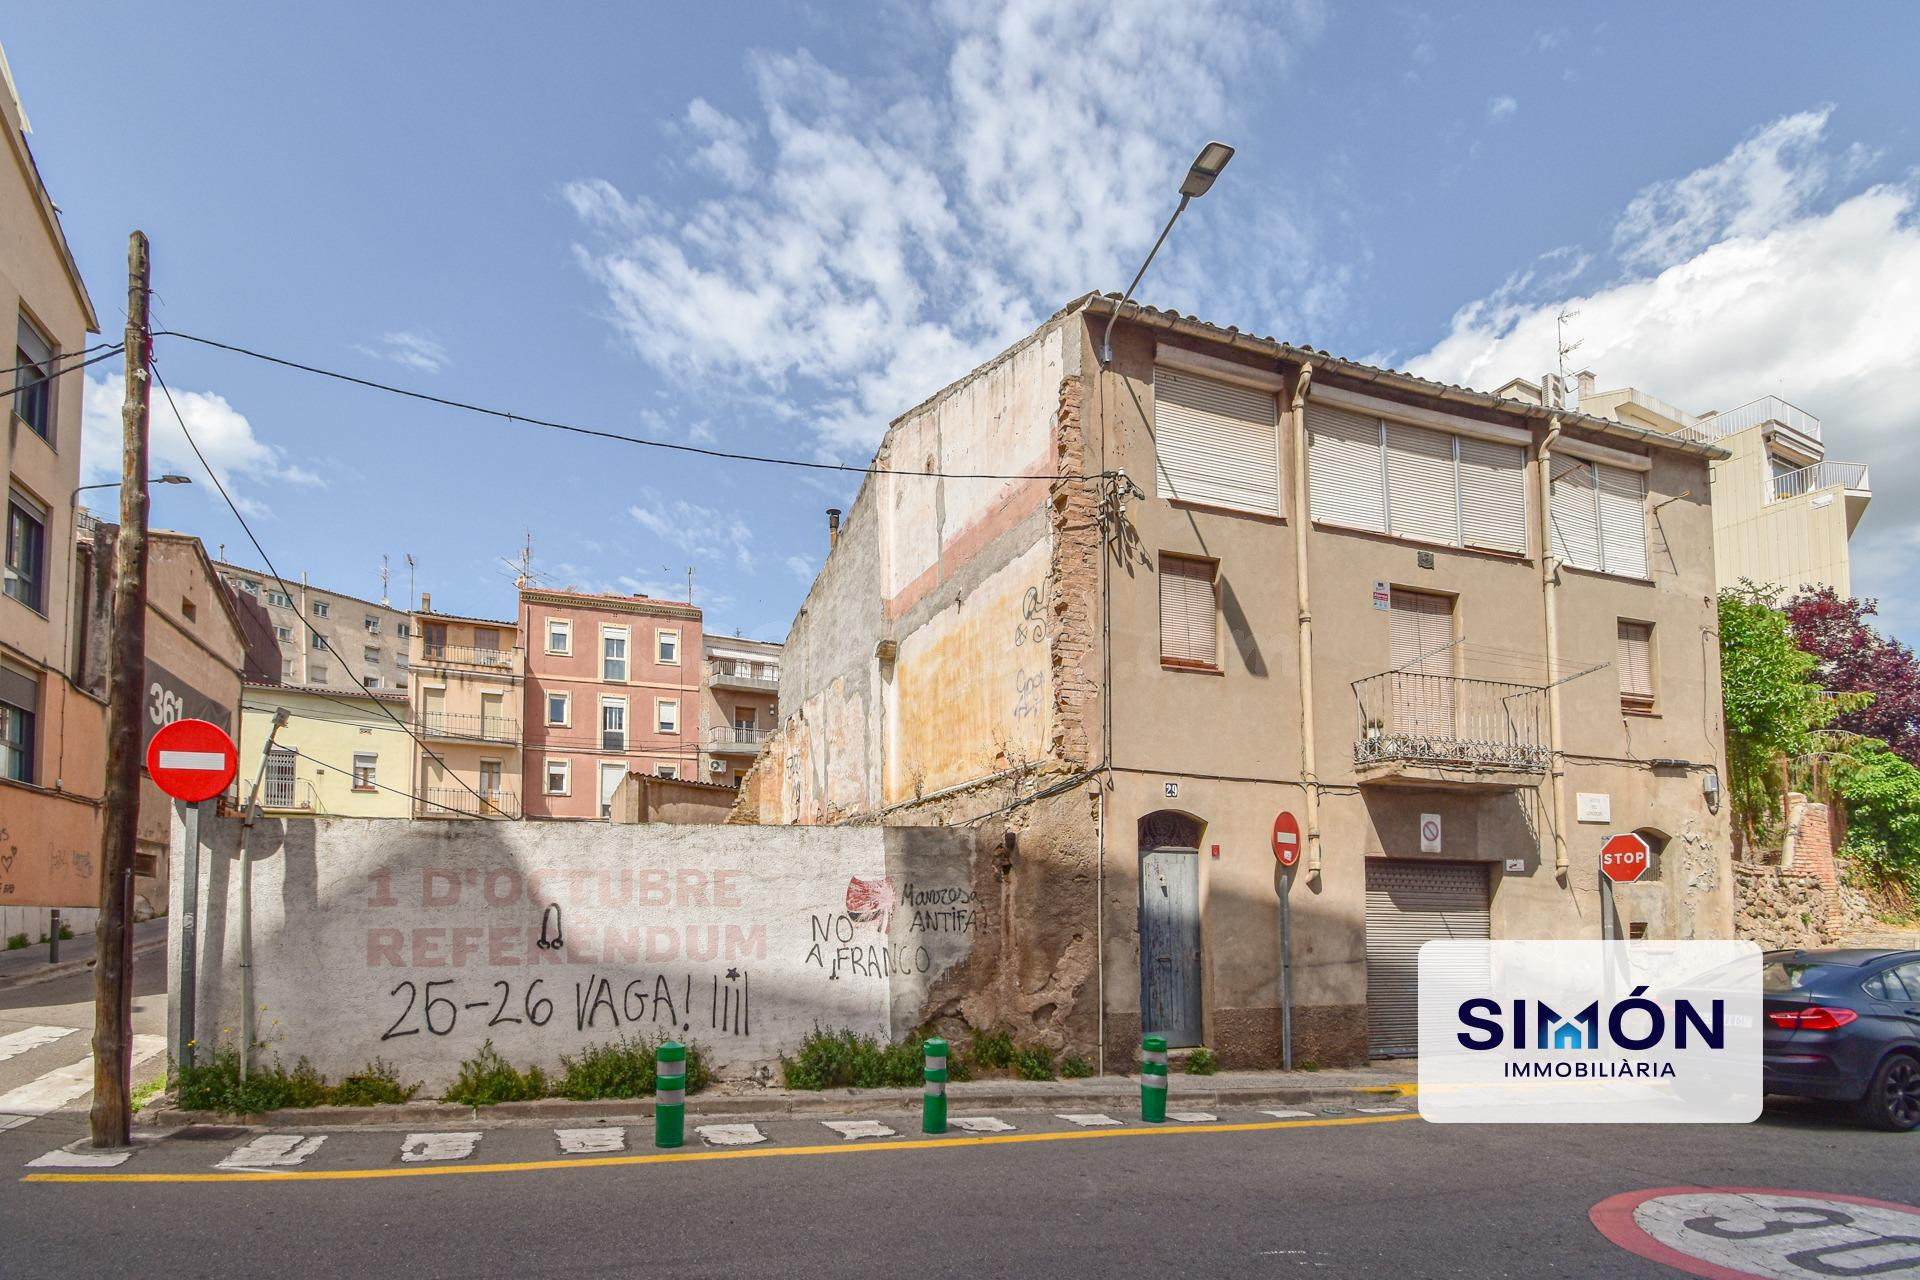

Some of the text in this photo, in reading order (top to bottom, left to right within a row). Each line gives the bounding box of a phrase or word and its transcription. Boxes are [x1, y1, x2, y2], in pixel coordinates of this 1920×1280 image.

[150, 682, 183, 726] 361
[1166, 784, 1177, 796] 29
[1603, 852, 1645, 864] STOP
[367, 866, 743, 909] 1 D'OCTUBRE
[812, 913, 854, 943] NO
[805, 943, 824, 968] A
[576, 974, 691, 1031] VAGA!
